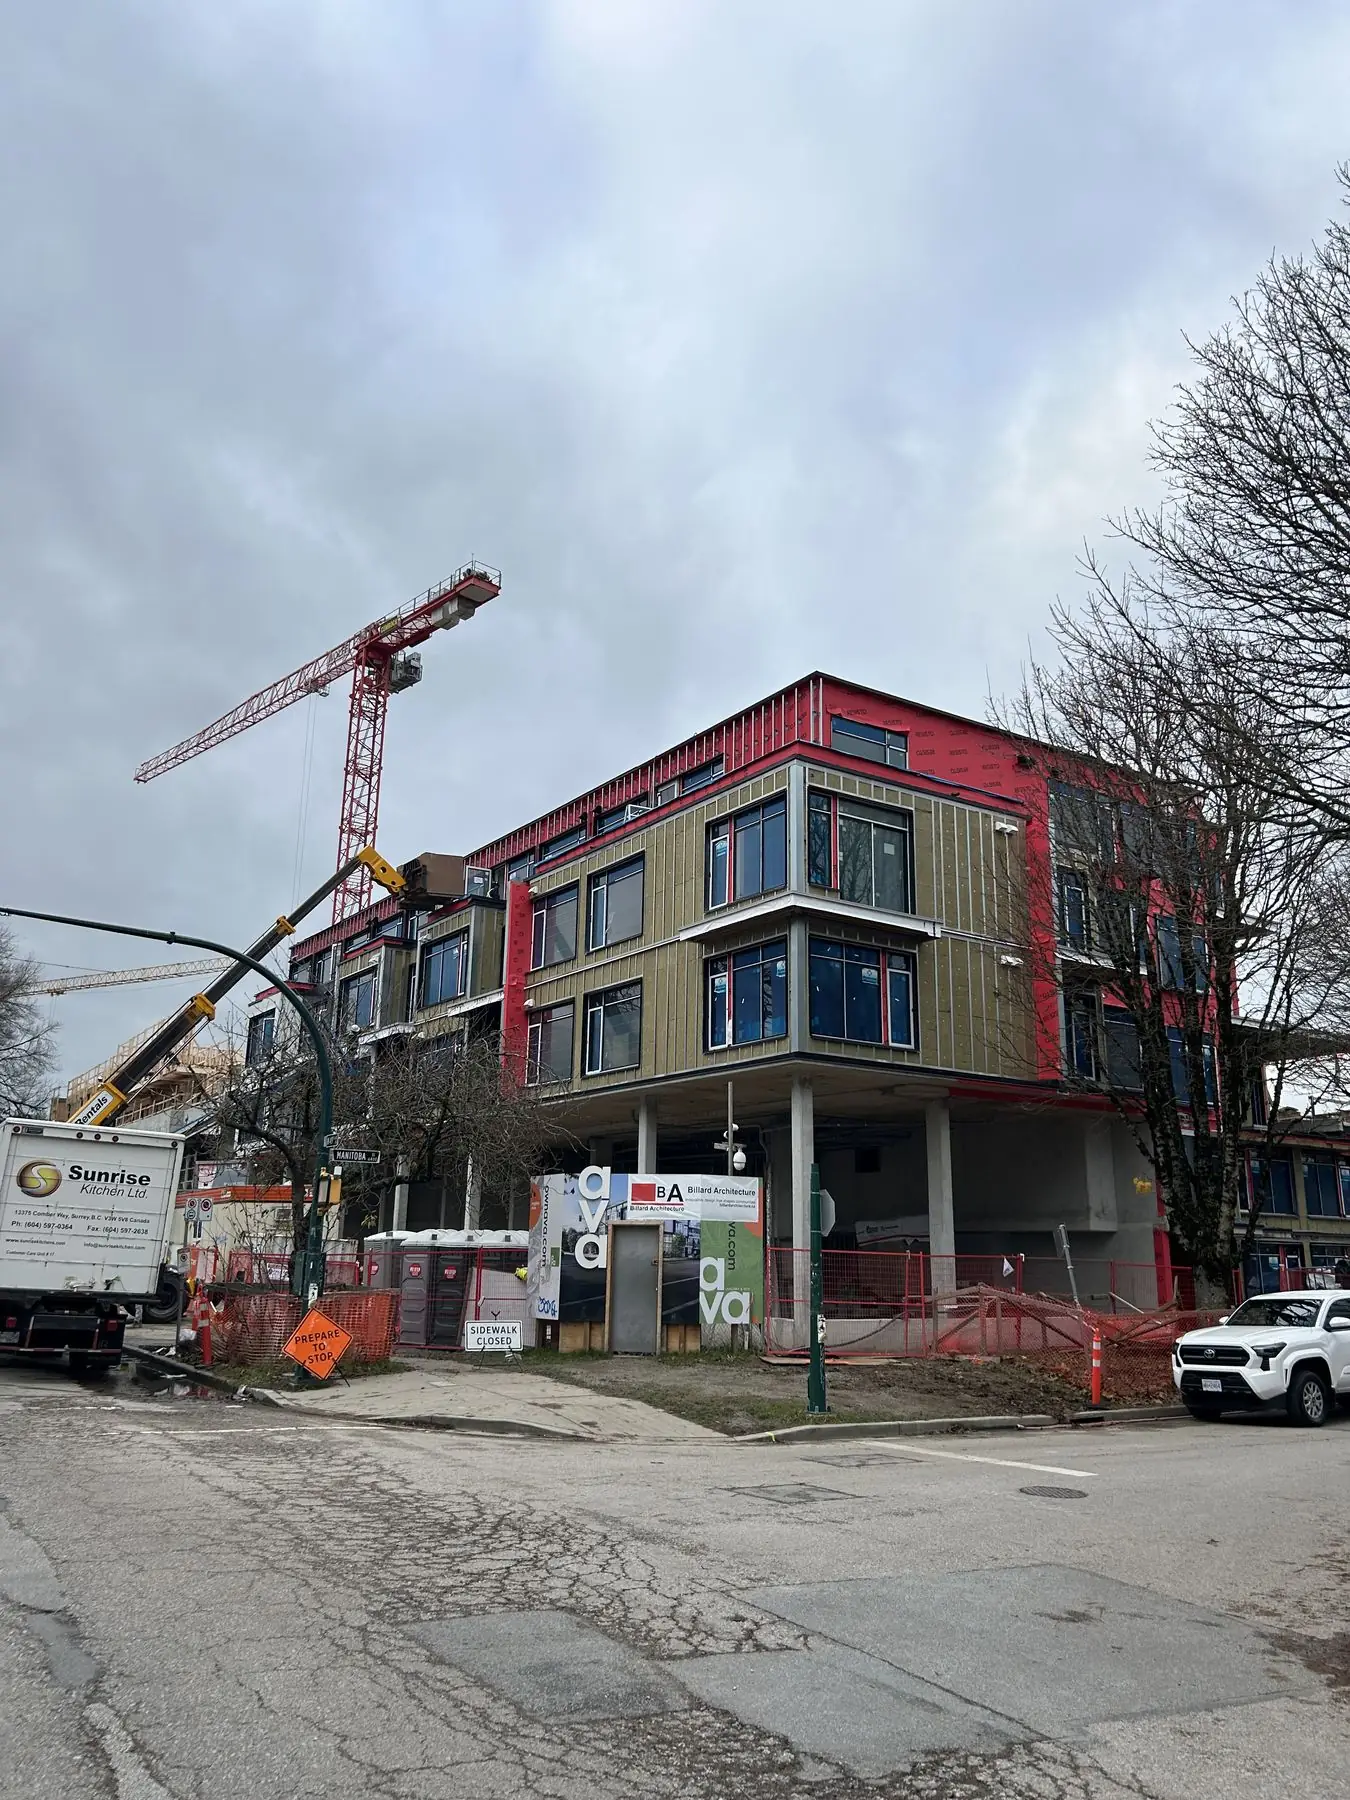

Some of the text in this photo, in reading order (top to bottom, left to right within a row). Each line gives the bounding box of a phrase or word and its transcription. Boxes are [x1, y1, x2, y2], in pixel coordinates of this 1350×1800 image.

[74, 1096, 108, 1125] Rentals
[336, 1151, 367, 1161] MANITOBA
[68, 1165, 151, 1186] Sunrise
[80, 1183, 148, 1199] Kitchen Ltd.
[687, 1186, 756, 1197] Billard Architecture
[24, 1221, 42, 1230] (604)
[541, 1185, 550, 1267] ownava.com
[727, 1221, 736, 1271] va.com
[294, 1329, 341, 1344] PREPARE
[470, 1326, 518, 1335] SIDEWALK
[312, 1342, 326, 1352] TO
[476, 1336, 512, 1345] CLOSED
[307, 1351, 334, 1364] STOP
